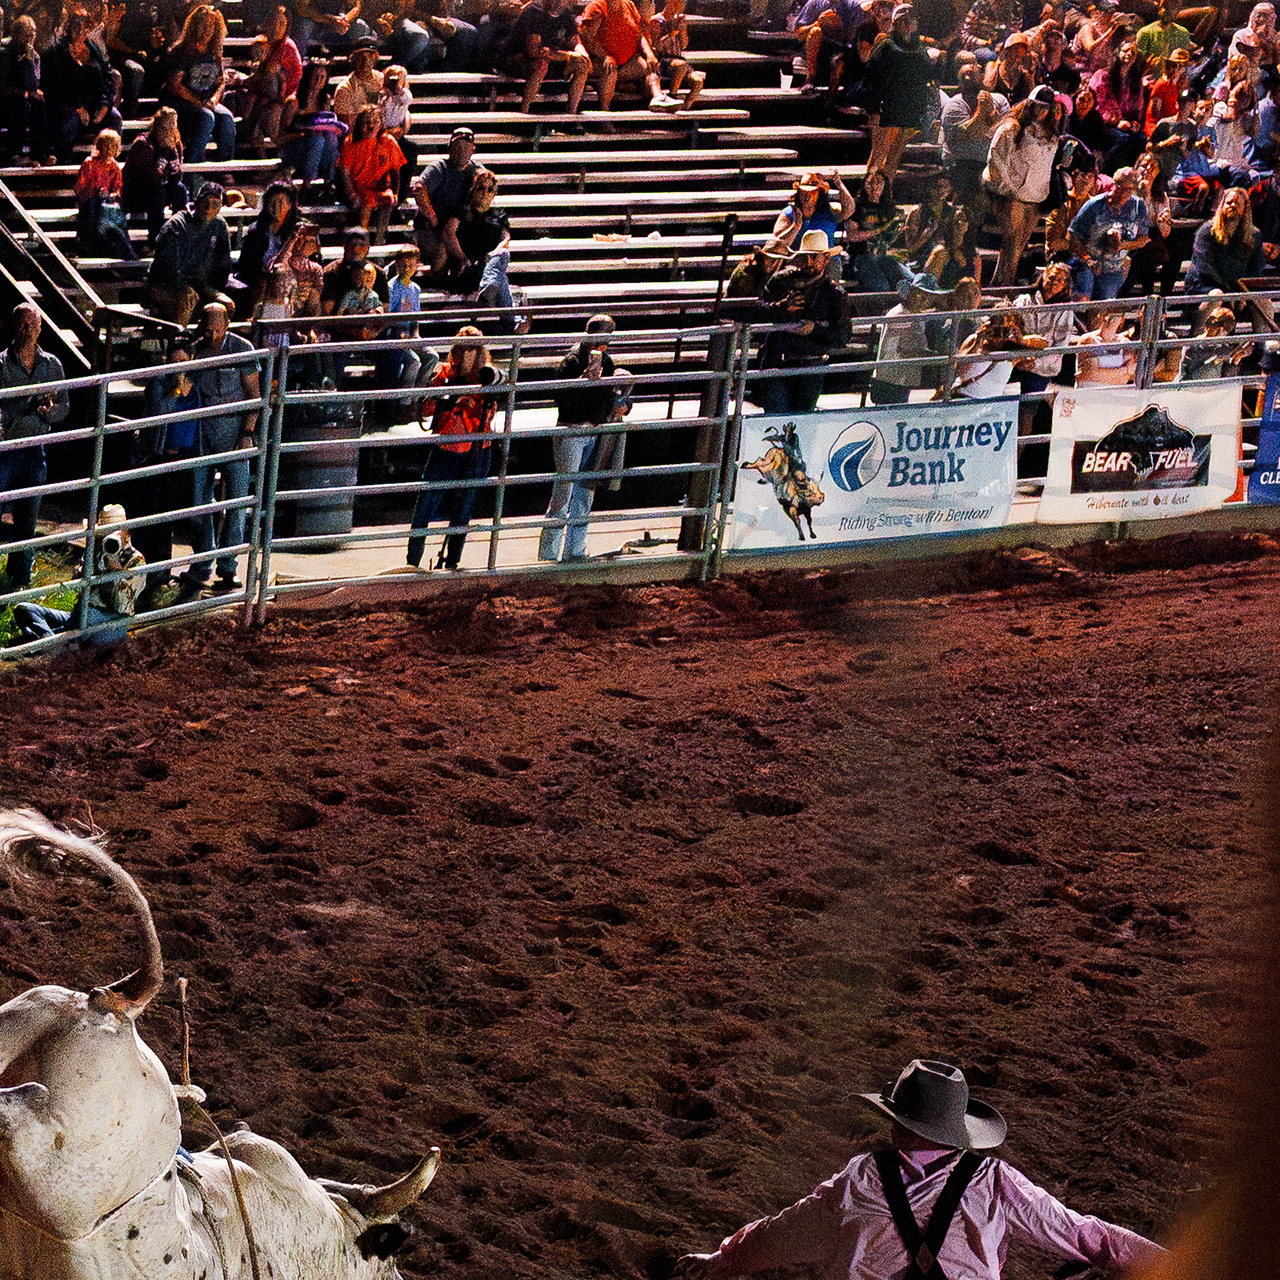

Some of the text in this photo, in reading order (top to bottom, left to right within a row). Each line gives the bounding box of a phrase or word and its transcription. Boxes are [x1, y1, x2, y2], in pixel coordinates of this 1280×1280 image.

[890, 420, 1013, 453] Journey
[888, 452, 966, 487] Bank
[1082, 447, 1199, 473] BEAR FUEL
[839, 516, 877, 532] Riding
[914, 510, 944, 524] with
[945, 506, 994, 522] Benton!
